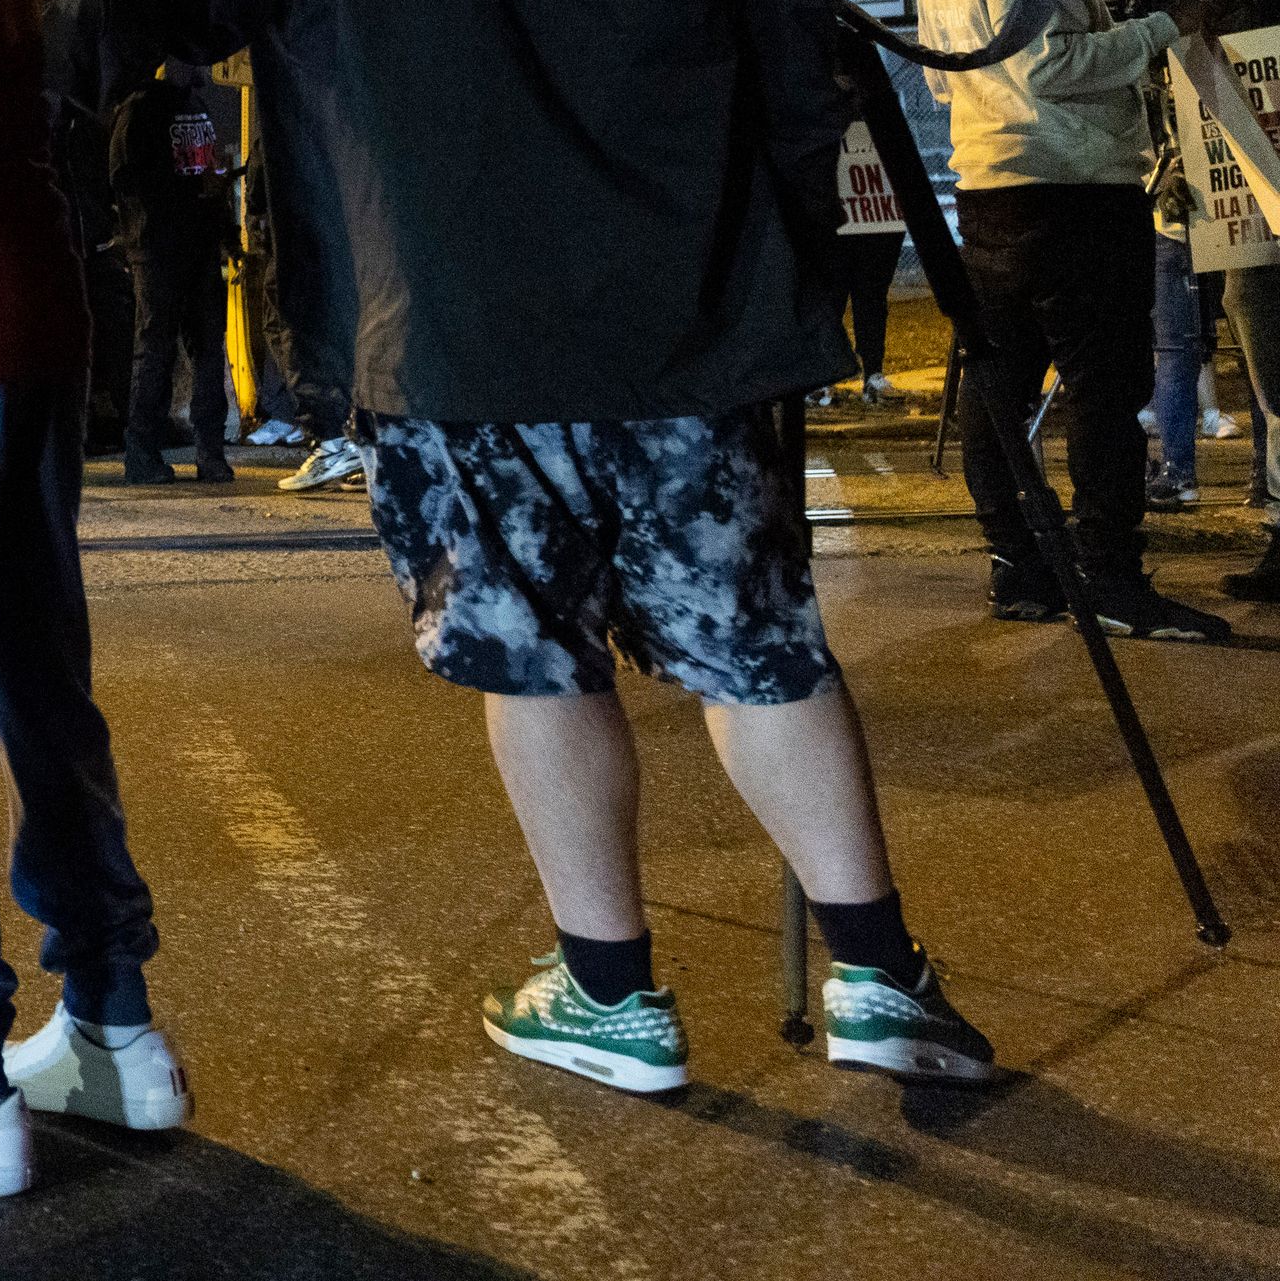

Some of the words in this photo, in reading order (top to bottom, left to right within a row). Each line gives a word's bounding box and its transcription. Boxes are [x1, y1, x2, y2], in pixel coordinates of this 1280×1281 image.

[848, 163, 884, 195] ON
[840, 194, 904, 223] TRIK
[1214, 196, 1241, 220] ILA
